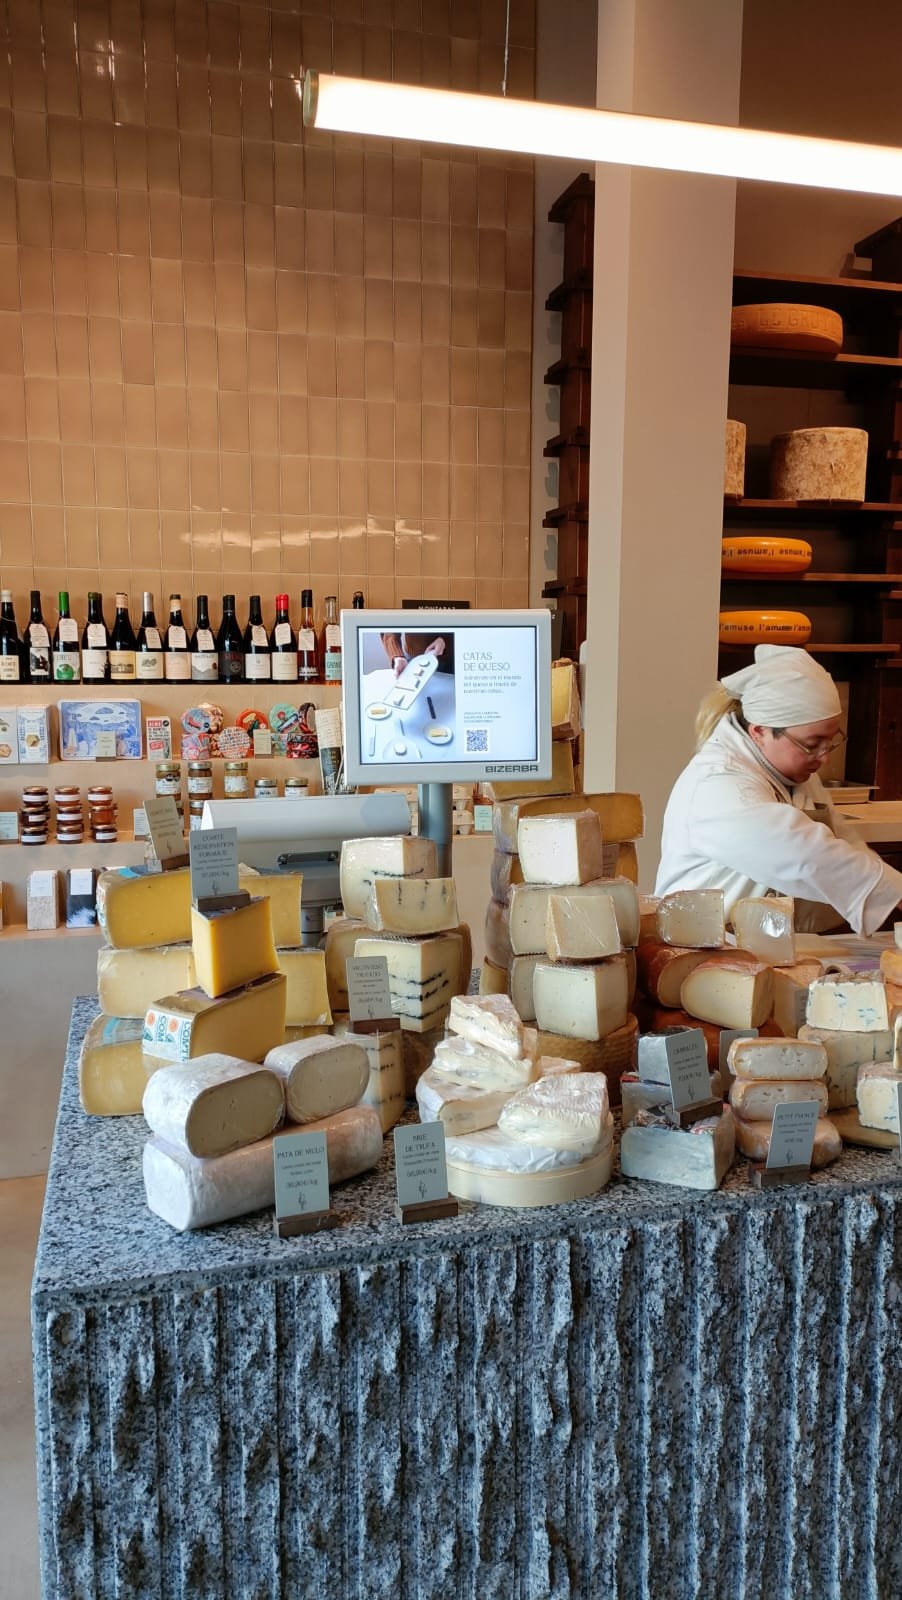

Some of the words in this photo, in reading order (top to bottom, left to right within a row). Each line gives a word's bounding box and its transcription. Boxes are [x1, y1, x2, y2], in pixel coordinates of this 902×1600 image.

[738, 548, 774, 557] l'amuse
[463, 652, 493, 661] CATAS
[463, 662, 476, 671] DE
[478, 662, 510, 671] QUESO
[485, 765, 539, 773] BIZERBA
[412, 1133, 428, 1142] BRIE
[405, 1144, 414, 1152] DE
[277, 1150, 294, 1160] PATA
